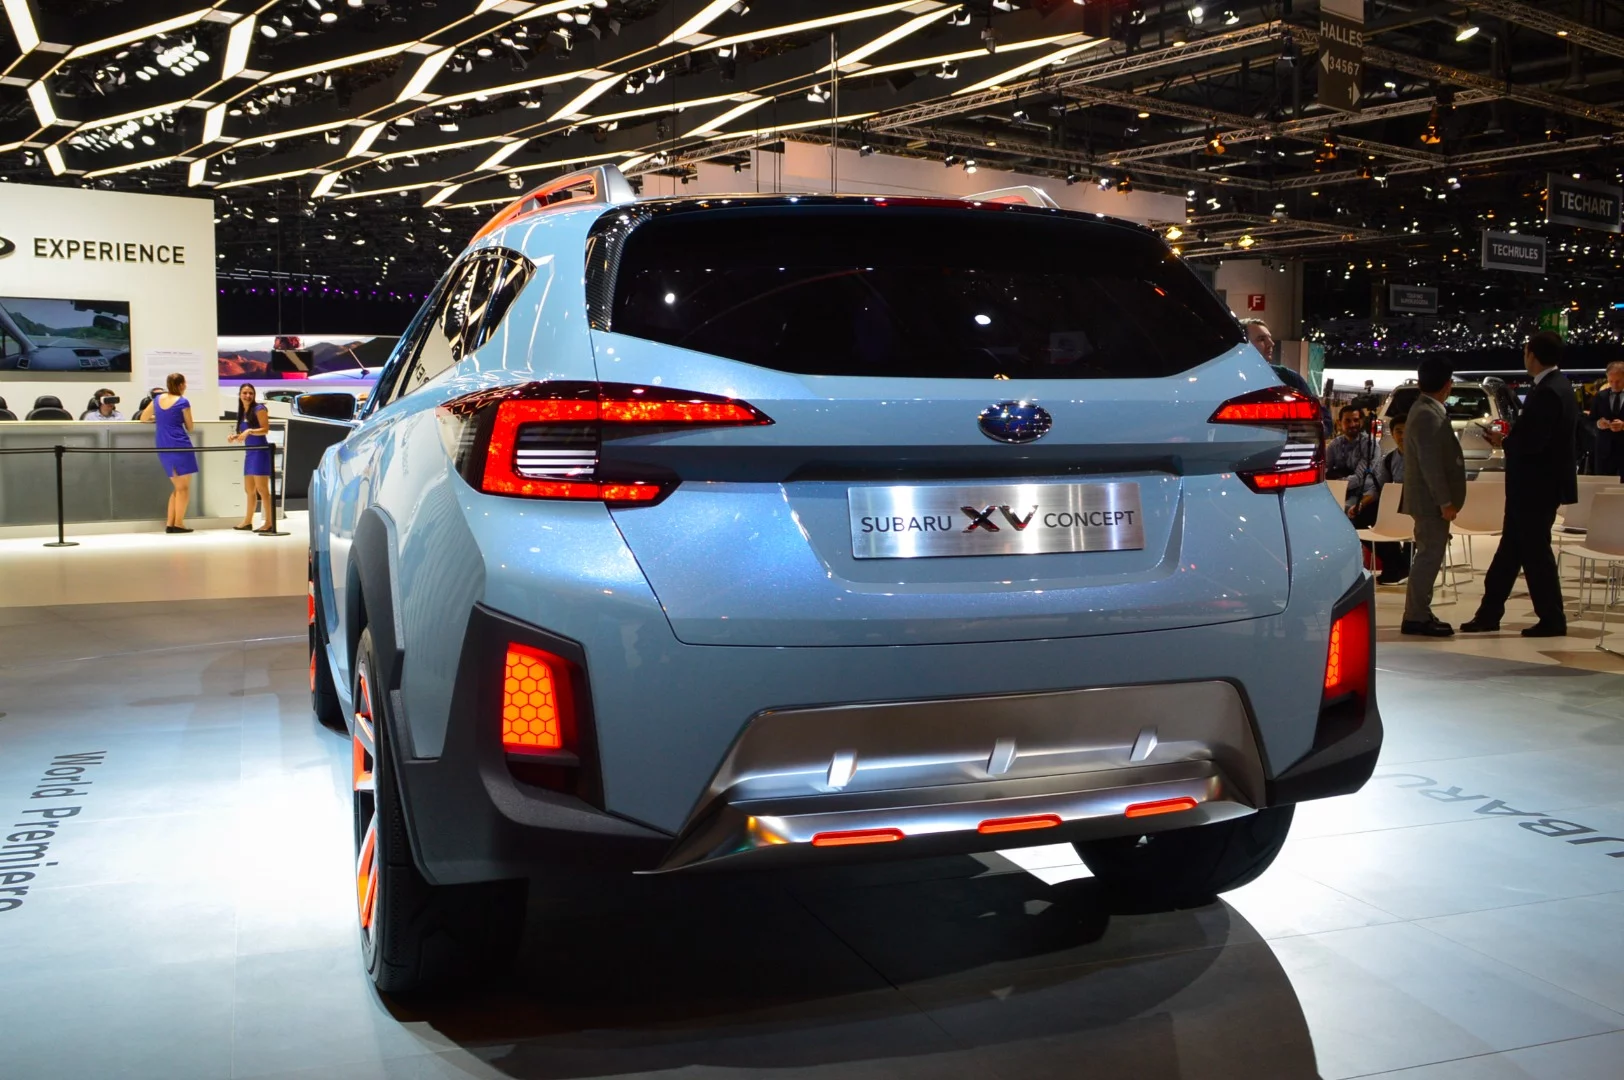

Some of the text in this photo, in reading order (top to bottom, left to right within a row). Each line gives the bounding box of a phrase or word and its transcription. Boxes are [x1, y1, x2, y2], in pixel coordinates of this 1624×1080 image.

[1320, 20, 1363, 48] HALLES
[1347, 86, 1352, 100] 1
[1560, 190, 1613, 217] TECHART
[33, 237, 186, 264] EXPERIENCE
[1492, 243, 1539, 260] TECHRULES
[1252, 295, 1262, 307] F
[861, 504, 1135, 533] SUBARU XV CONCEPT
[30, 750, 107, 799] World
